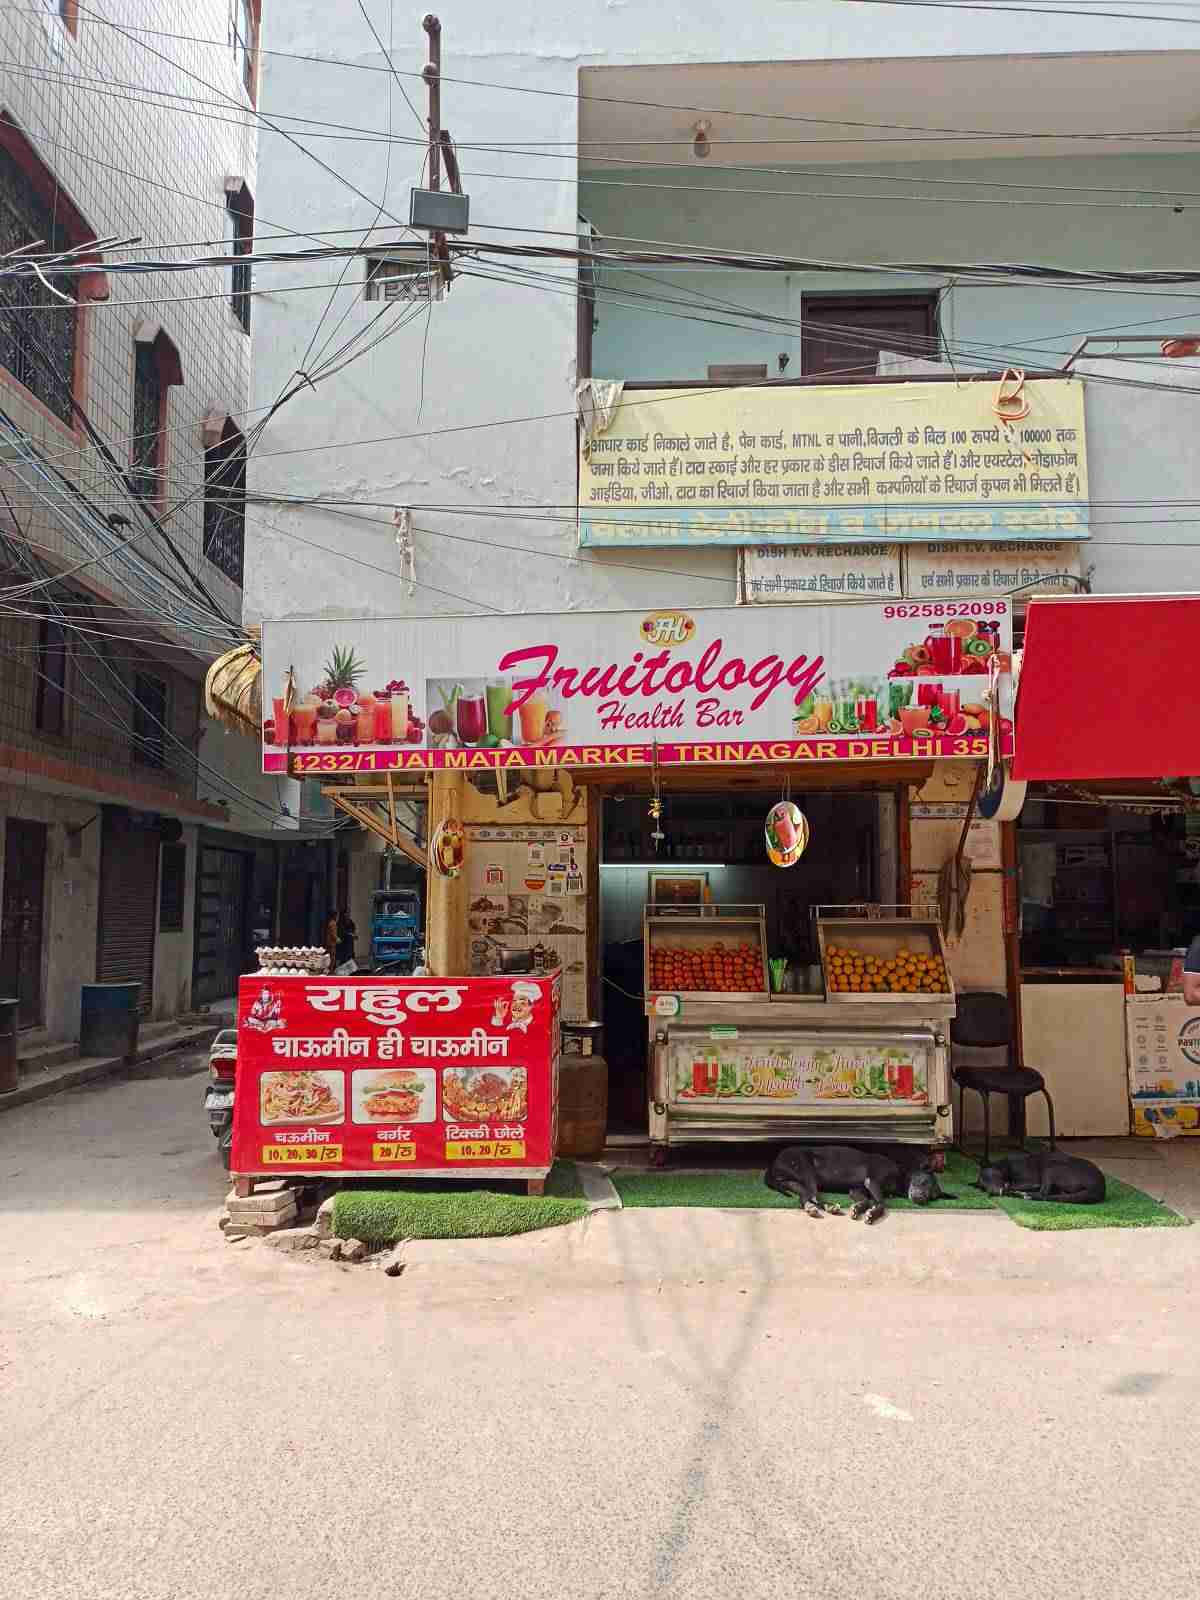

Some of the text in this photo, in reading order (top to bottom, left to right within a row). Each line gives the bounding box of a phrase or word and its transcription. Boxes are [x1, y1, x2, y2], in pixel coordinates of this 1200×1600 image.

[592, 439, 622, 452] आधार
[627, 433, 648, 452] कार्ड
[654, 433, 690, 452] निकाले
[695, 433, 716, 451] जाते
[793, 433, 821, 448] MTNL
[826, 434, 834, 446] व
[908, 427, 919, 444] के
[924, 426, 945, 444] बिल
[952, 431, 966, 443] 100
[1021, 430, 1051, 443] 100000
[1057, 429, 1076, 442] तक
[591, 464, 614, 477] जमा
[617, 458, 640, 476] किये
[644, 458, 666, 476] जाते
[686, 463, 705, 475] टाटा
[708, 457, 737, 475] स्काई
[740, 455, 760, 473] और
[764, 462, 778, 474] हर
[782, 461, 809, 475] प्रकार
[814, 454, 824, 473] के
[853, 450, 886, 471] रिचार्ज
[890, 450, 912, 470] किये
[917, 451, 939, 469] जाते
[960, 448, 980, 468] और
[677, 487, 696, 499] टाटा
[699, 486, 714, 499] का
[718, 480, 749, 499] रिचार्ज
[753, 480, 779, 498] किया
[783, 484, 808, 497] जाता
[812, 481, 820, 498] है
[824, 475, 844, 497] और
[847, 474, 869, 496] सभी
[929, 475, 940, 494] के
[945, 472, 977, 494] रिचार्ज
[1013, 473, 1026, 493] भी
[1030, 472, 1061, 493] मिलते
[758, 544, 888, 558] DISH T.V. RECHARGE
[884, 602, 1007, 619] 9625852098
[499, 638, 826, 717] Fruitology
[597, 698, 744, 731] Health Bar
[388, 752, 434, 769] JAI
[444, 750, 527, 768] MATA
[674, 743, 845, 761] TRINAGAR
[848, 740, 943, 757] DELHI
[953, 740, 989, 755] 35
[305, 985, 468, 1025] राहुल
[273, 1027, 509, 1059] चाऊमीन ही चाऊमीन
[494, 1124, 525, 1139] छोले
